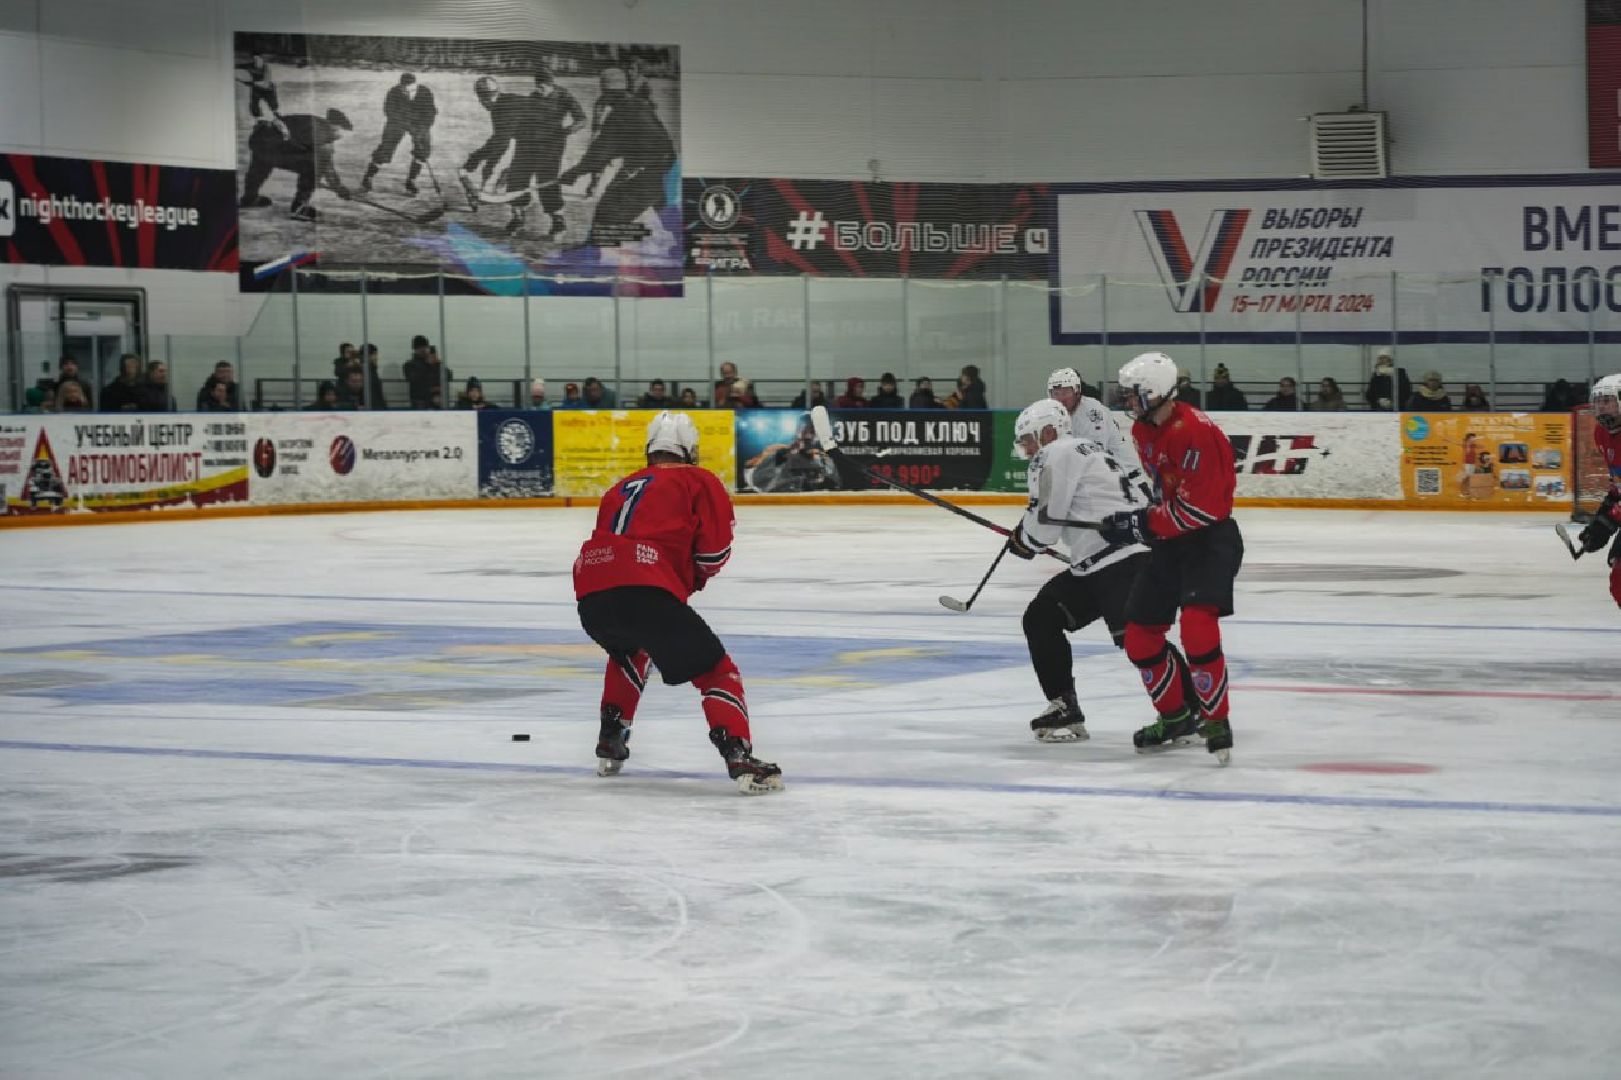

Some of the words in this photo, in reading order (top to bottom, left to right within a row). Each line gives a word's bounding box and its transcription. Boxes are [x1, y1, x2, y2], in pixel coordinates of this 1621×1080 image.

[20, 193, 199, 231] nighthockeyleague
[1261, 207, 1364, 230] ВЫБОРЫ
[1249, 236, 1395, 260] ПРЕЗИДЕНТА
[1238, 267, 1333, 288] РОССИИ
[1277, 295, 1331, 313] МАРТА
[1334, 294, 1375, 312] 2024
[74, 419, 145, 448] УЧЕБНЫЙ
[148, 424, 193, 451] ЦЕНТР
[834, 421, 870, 443] ЗУБ
[876, 421, 919, 445] ПОД
[924, 421, 981, 443] КЛЮЧ
[362, 448, 440, 463] Металлургия
[67, 452, 203, 484] АВТОМОБИЛИСТ
[611, 474, 654, 535] 7
